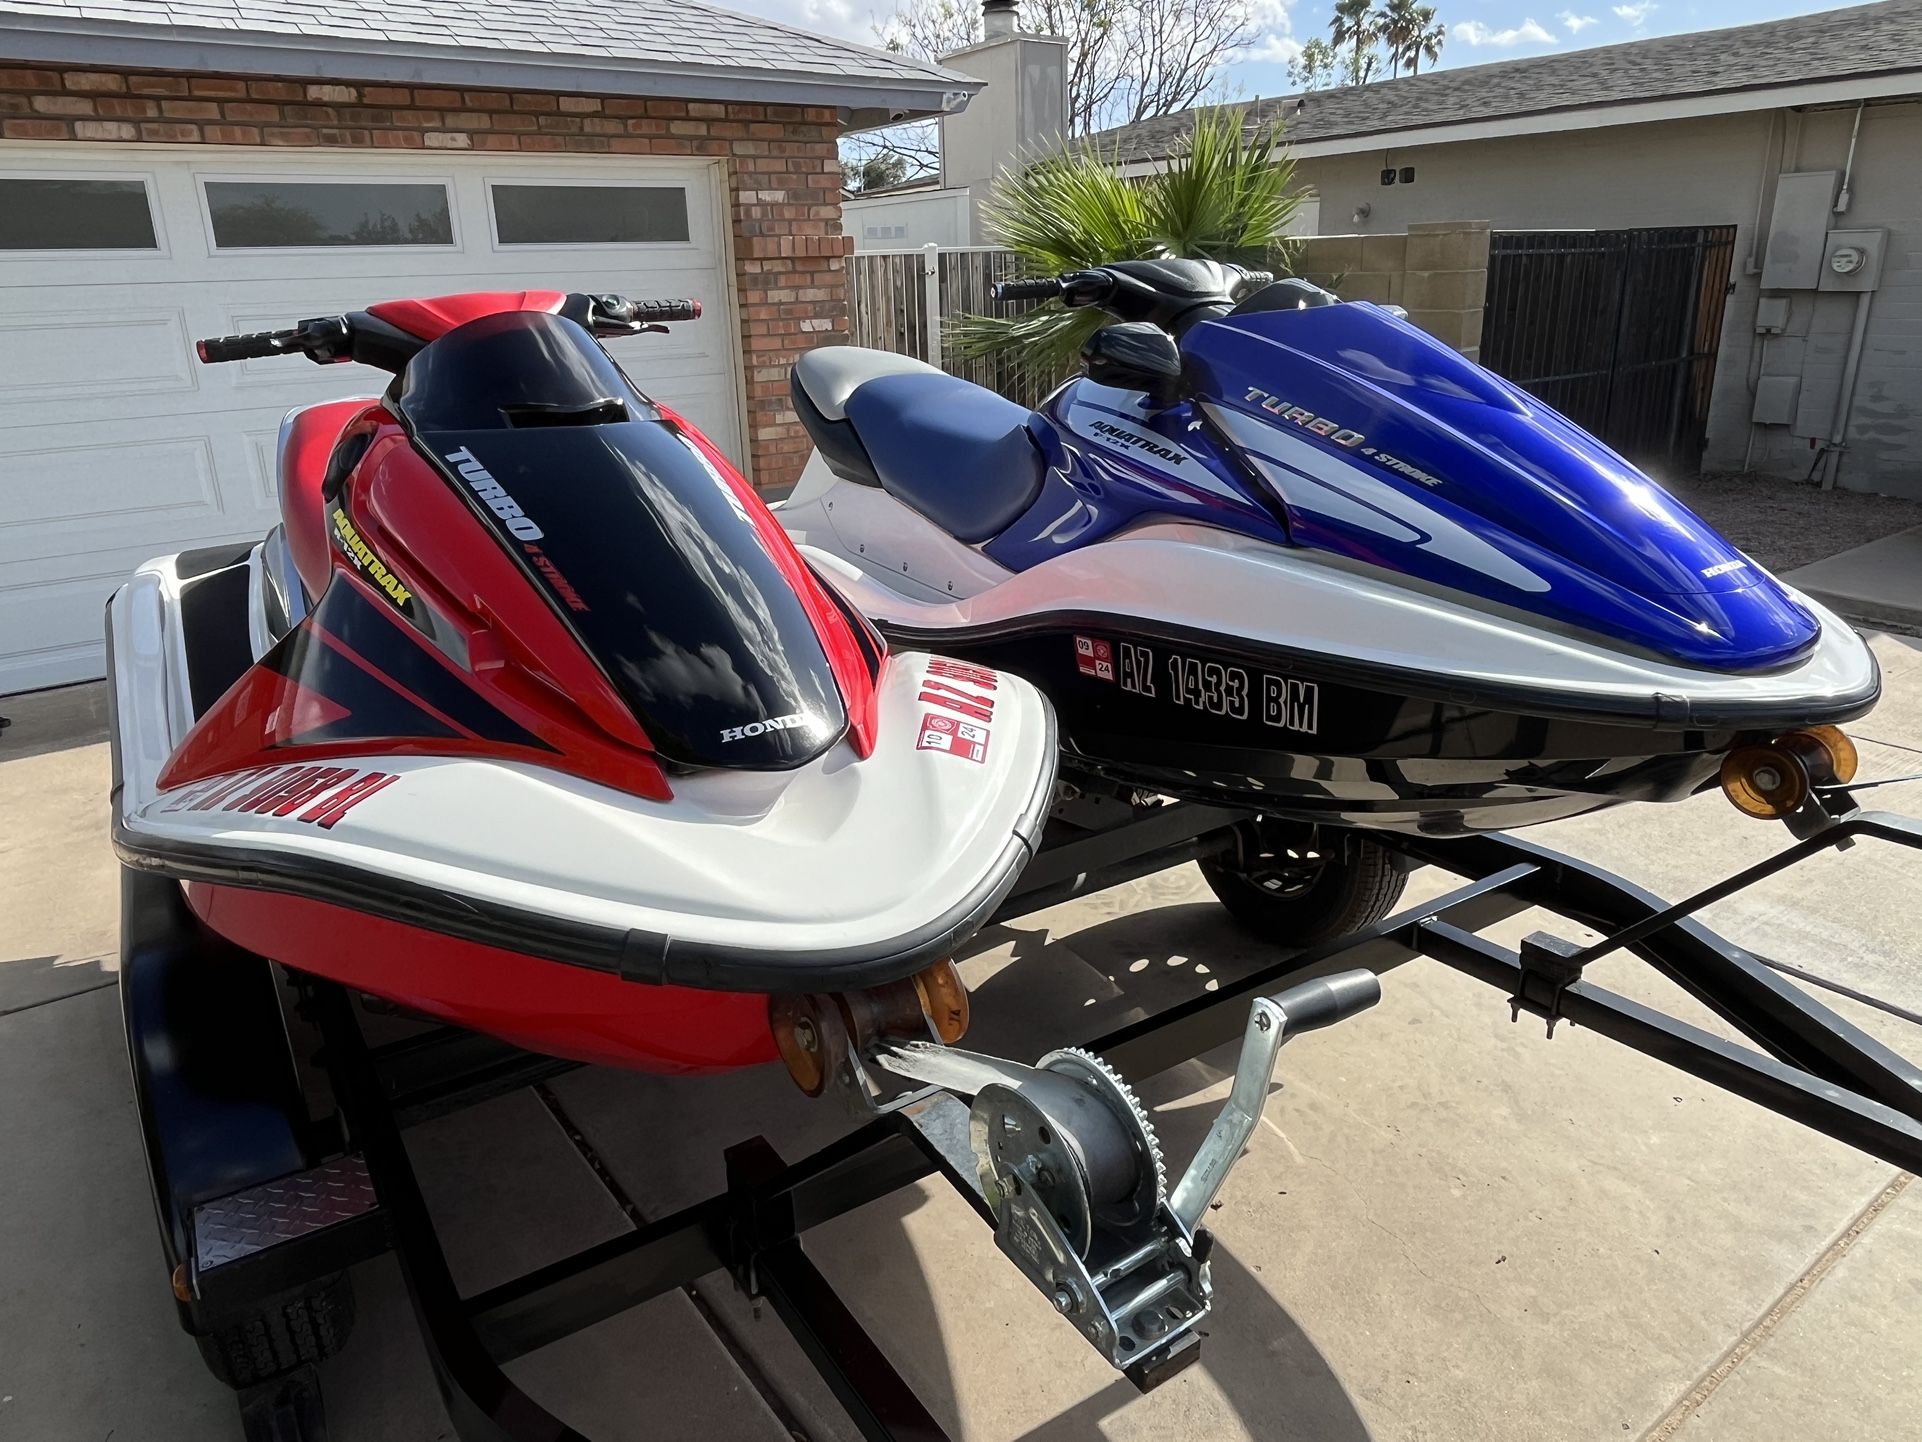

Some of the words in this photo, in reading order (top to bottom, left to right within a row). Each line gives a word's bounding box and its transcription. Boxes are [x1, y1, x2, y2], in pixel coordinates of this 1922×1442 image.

[1088, 420, 1189, 466] AQUATRAX
[1244, 386, 1366, 447] TURBO
[1361, 446, 1378, 456] 4
[1374, 453, 1444, 487] STROKE
[444, 445, 545, 541] TURBO
[332, 507, 413, 607] AQUATRAX
[1078, 640, 1090, 651] 09
[1098, 662, 1111, 674] 24
[918, 679, 996, 723] AZ
[1120, 642, 1156, 697] AZ
[1168, 655, 1249, 720] 1433
[1263, 674, 1318, 735] BM
[720, 712, 818, 743] HOND
[925, 733, 943, 746] 10
[960, 724, 977, 740] 24
[297, 771, 401, 830] BL
